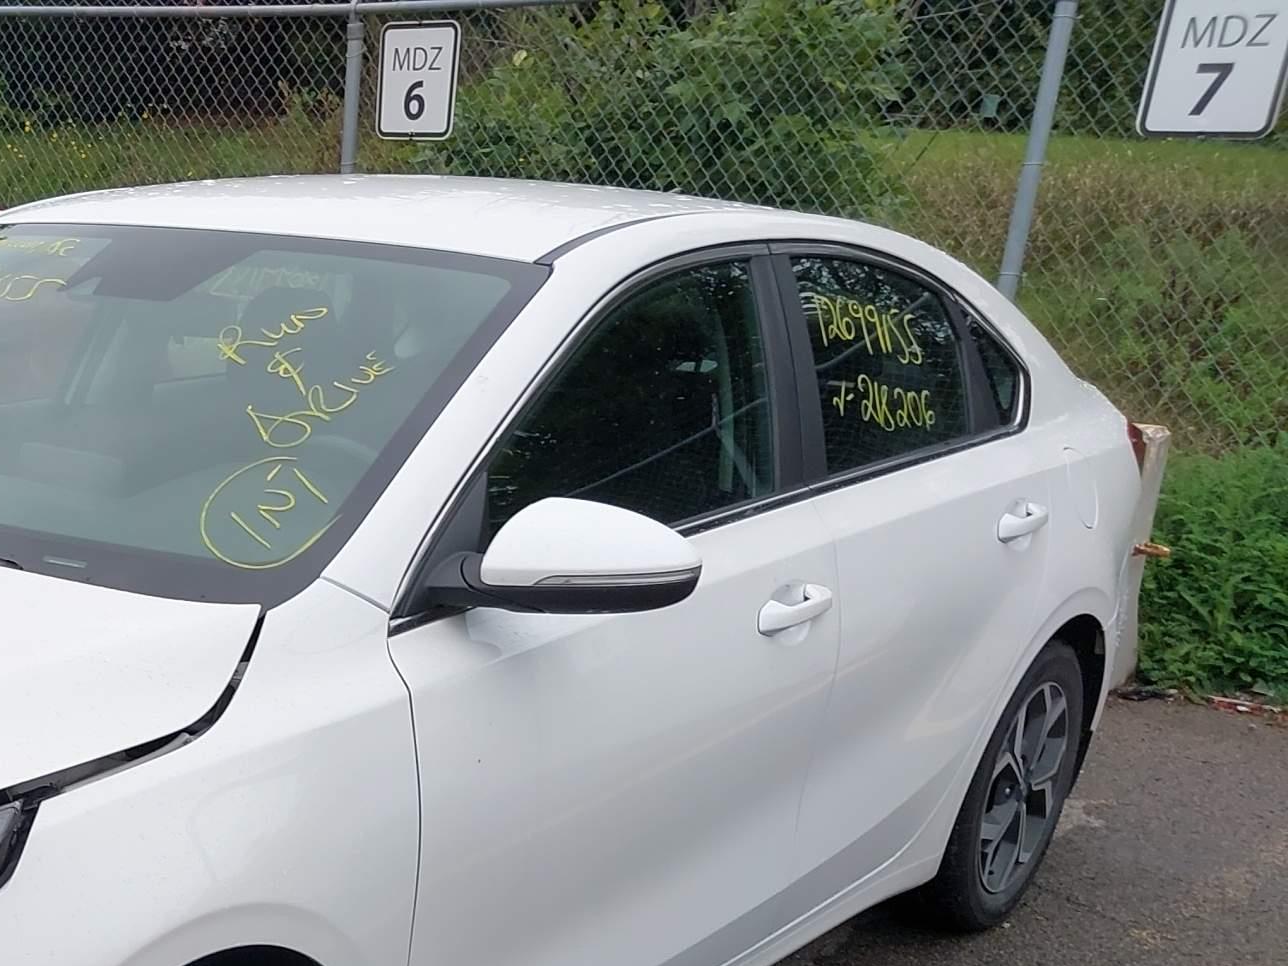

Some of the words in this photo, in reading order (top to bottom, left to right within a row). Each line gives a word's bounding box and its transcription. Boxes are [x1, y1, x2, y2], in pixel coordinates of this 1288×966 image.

[1180, 13, 1278, 49] MDZ
[392, 46, 444, 71] MDZ
[404, 80, 425, 121] 6
[1188, 62, 1236, 116] 7
